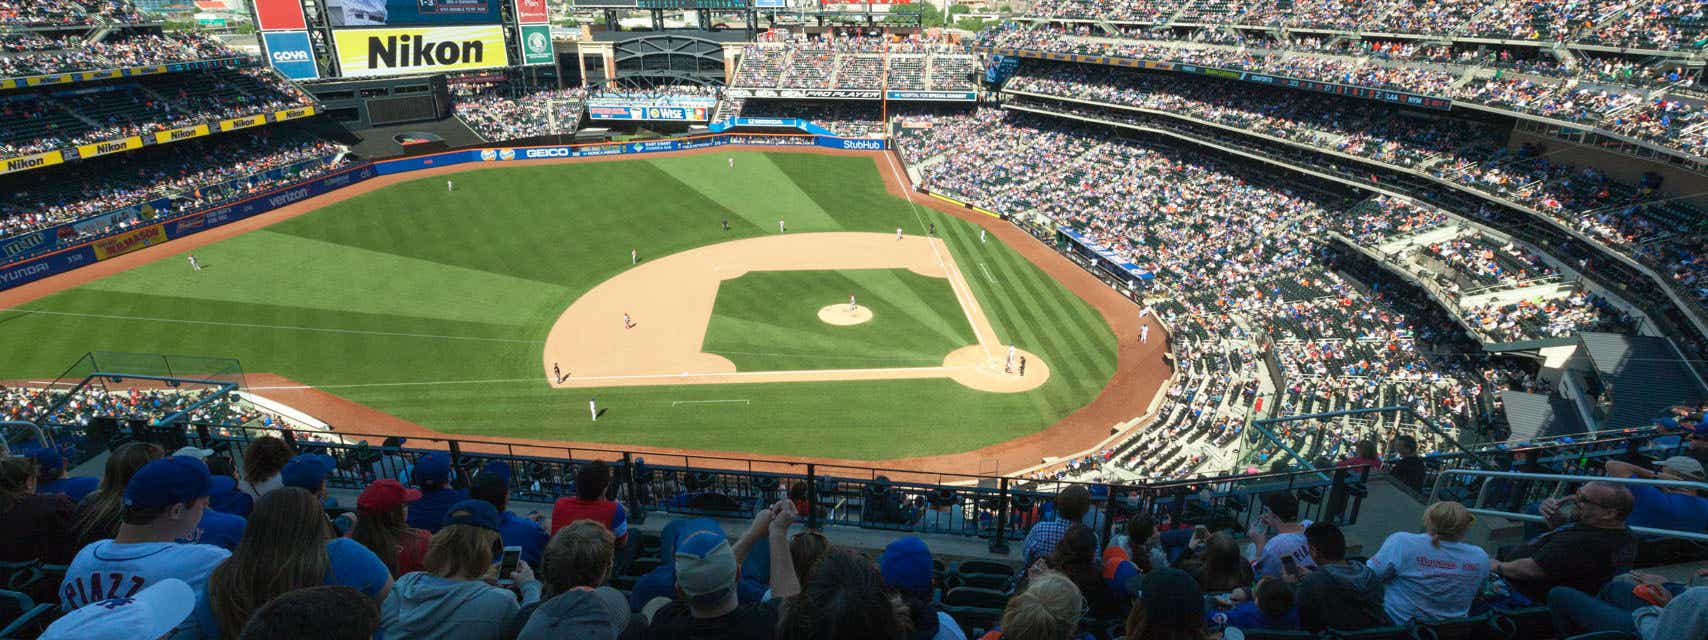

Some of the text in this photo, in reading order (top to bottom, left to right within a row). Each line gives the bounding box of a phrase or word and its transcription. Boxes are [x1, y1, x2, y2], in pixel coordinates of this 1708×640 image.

[273, 51, 308, 60] GOYA
[368, 34, 483, 69] Nikon
[233, 118, 254, 128] Nikon
[171, 129, 196, 139] Nikon
[97, 141, 127, 153] Nikon
[843, 140, 880, 149] StubHub
[526, 148, 568, 158] GEICO
[7, 157, 44, 171] Nikon
[268, 188, 308, 207] verizon
[0, 262, 49, 282] YUNDAI
[65, 573, 145, 609] PIAZZ
